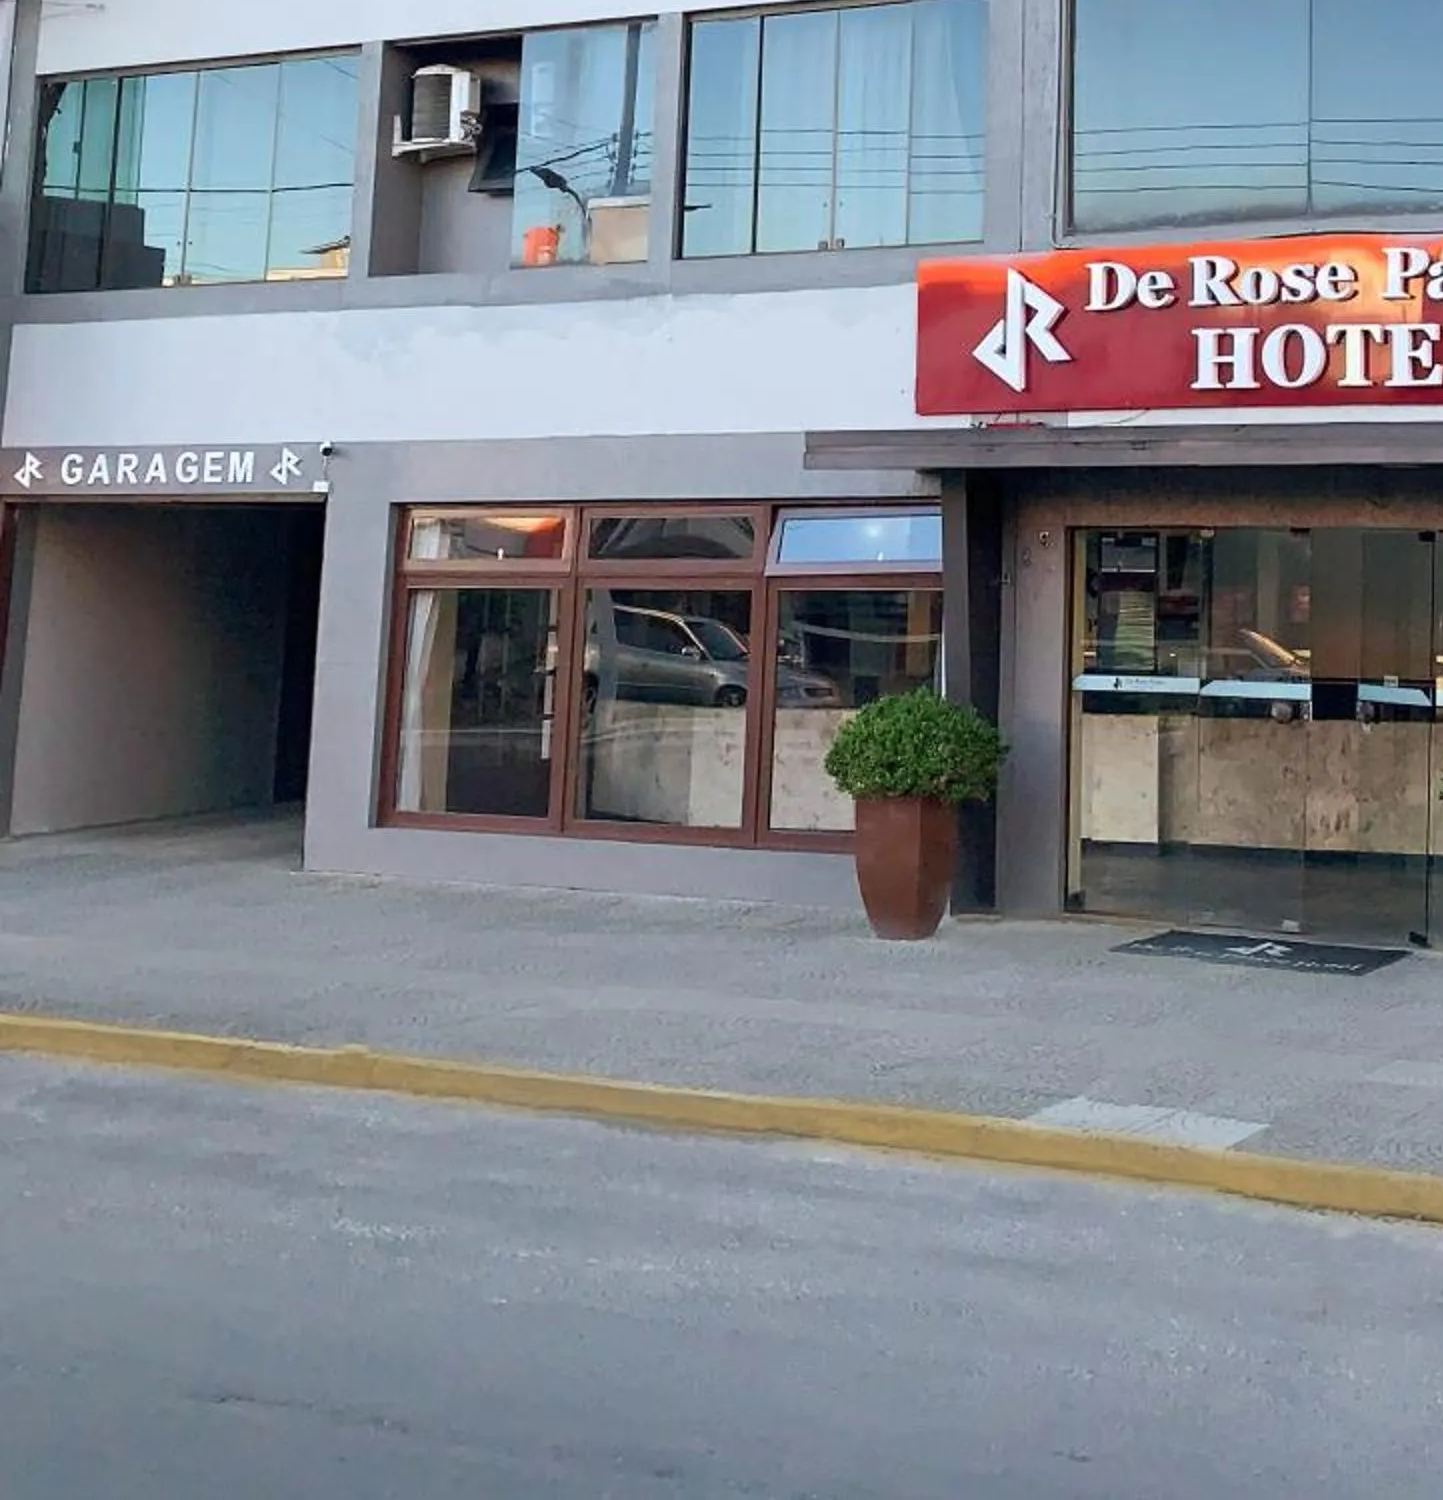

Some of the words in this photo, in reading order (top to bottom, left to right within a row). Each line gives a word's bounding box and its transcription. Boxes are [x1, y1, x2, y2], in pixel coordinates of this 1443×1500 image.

[1084, 262, 1175, 312] De
[1187, 255, 1357, 308] Rose
[60, 451, 256, 485] GARAGEM
